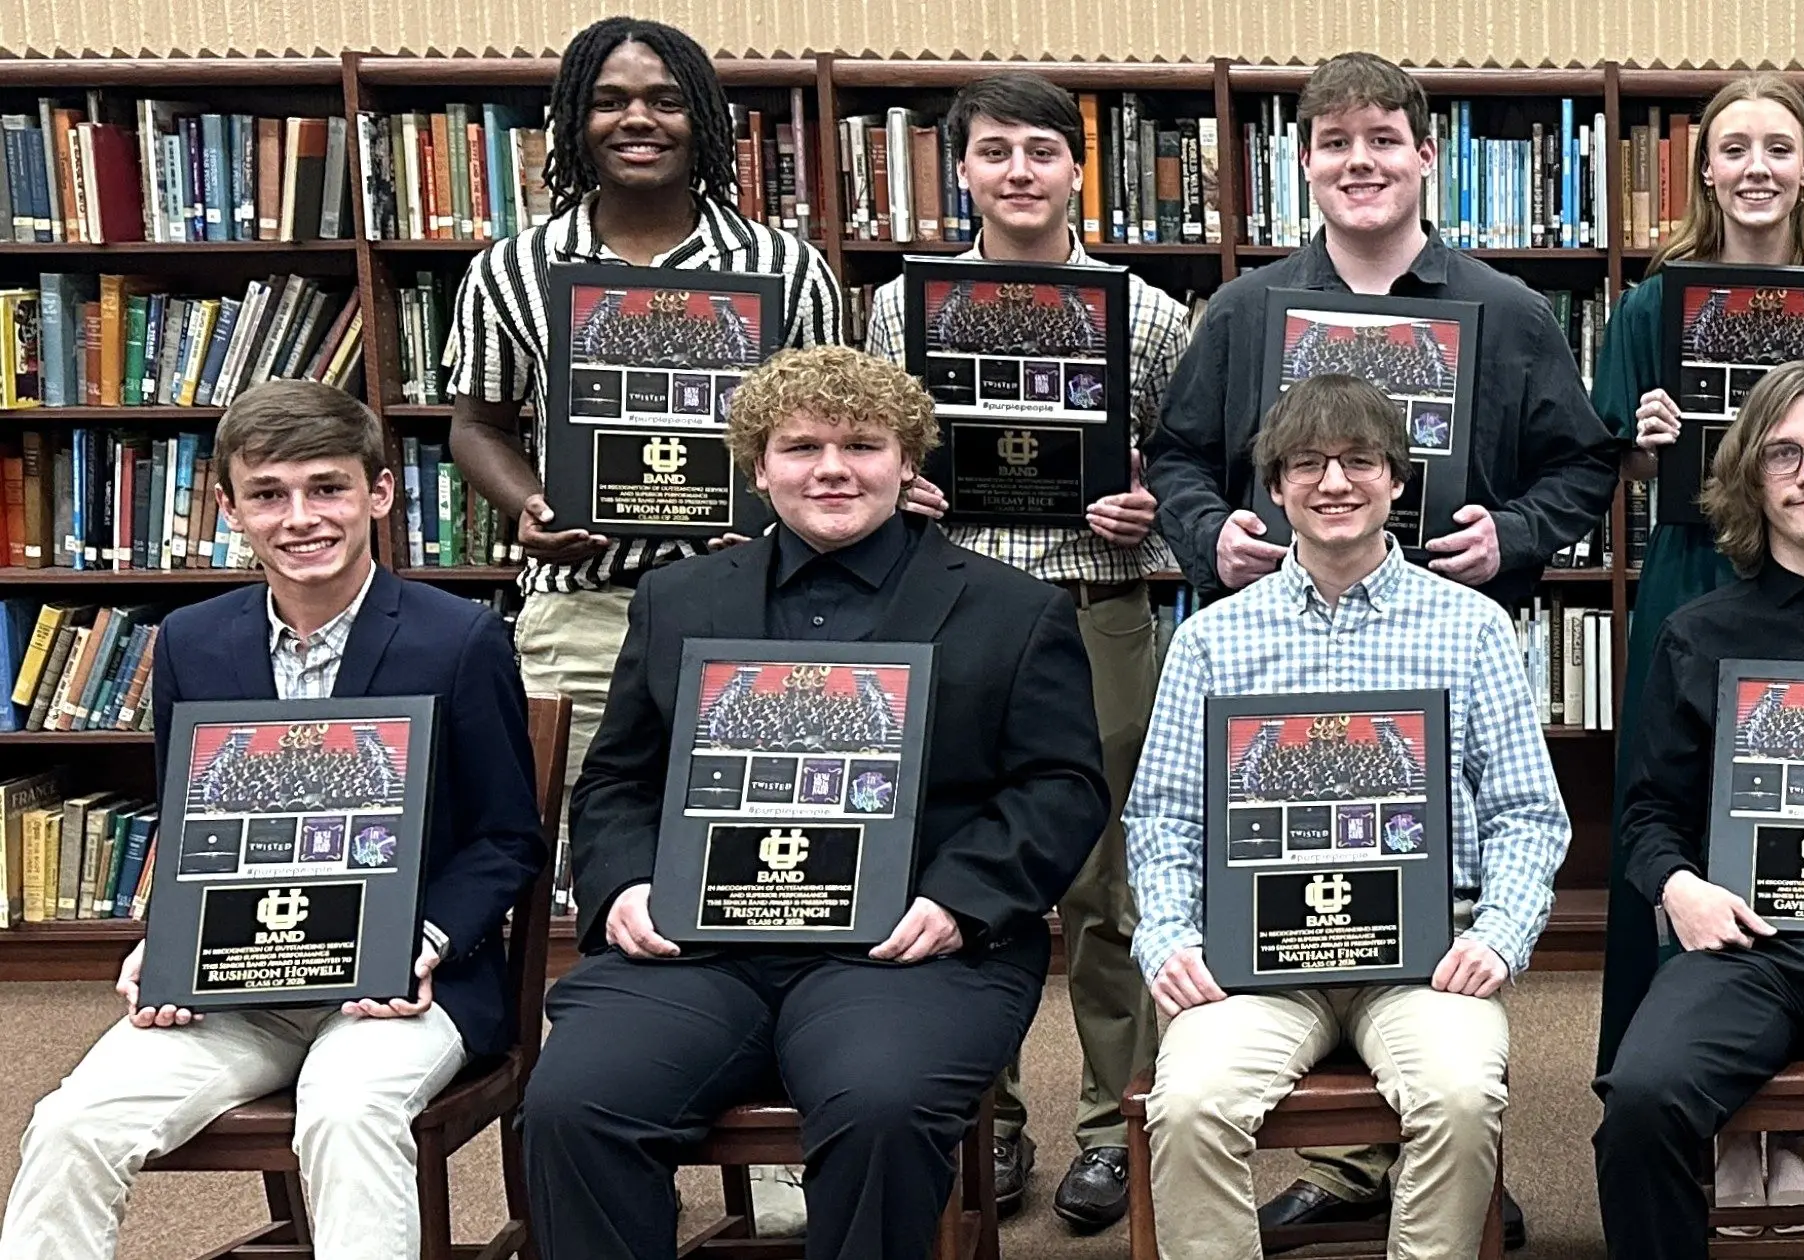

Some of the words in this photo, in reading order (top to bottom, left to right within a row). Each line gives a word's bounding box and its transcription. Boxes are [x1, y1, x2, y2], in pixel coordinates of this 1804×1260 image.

[1189, 138, 1198, 172] WORLD
[1190, 174, 1199, 194] WAR
[998, 465, 1038, 476] BAND
[643, 473, 685, 484] BAND
[616, 502, 659, 513] BYRON
[662, 504, 711, 515] ABBOTT
[757, 870, 805, 882] BAND
[723, 905, 780, 917] TRISTAN
[783, 906, 830, 918] LYNCH
[1306, 913, 1351, 926] BAND
[254, 929, 305, 943] BAND
[1279, 948, 1333, 961] NATHAN
[1337, 946, 1378, 958] FINCH
[207, 966, 281, 981] RUSHDON
[284, 963, 345, 978] HOWELL
